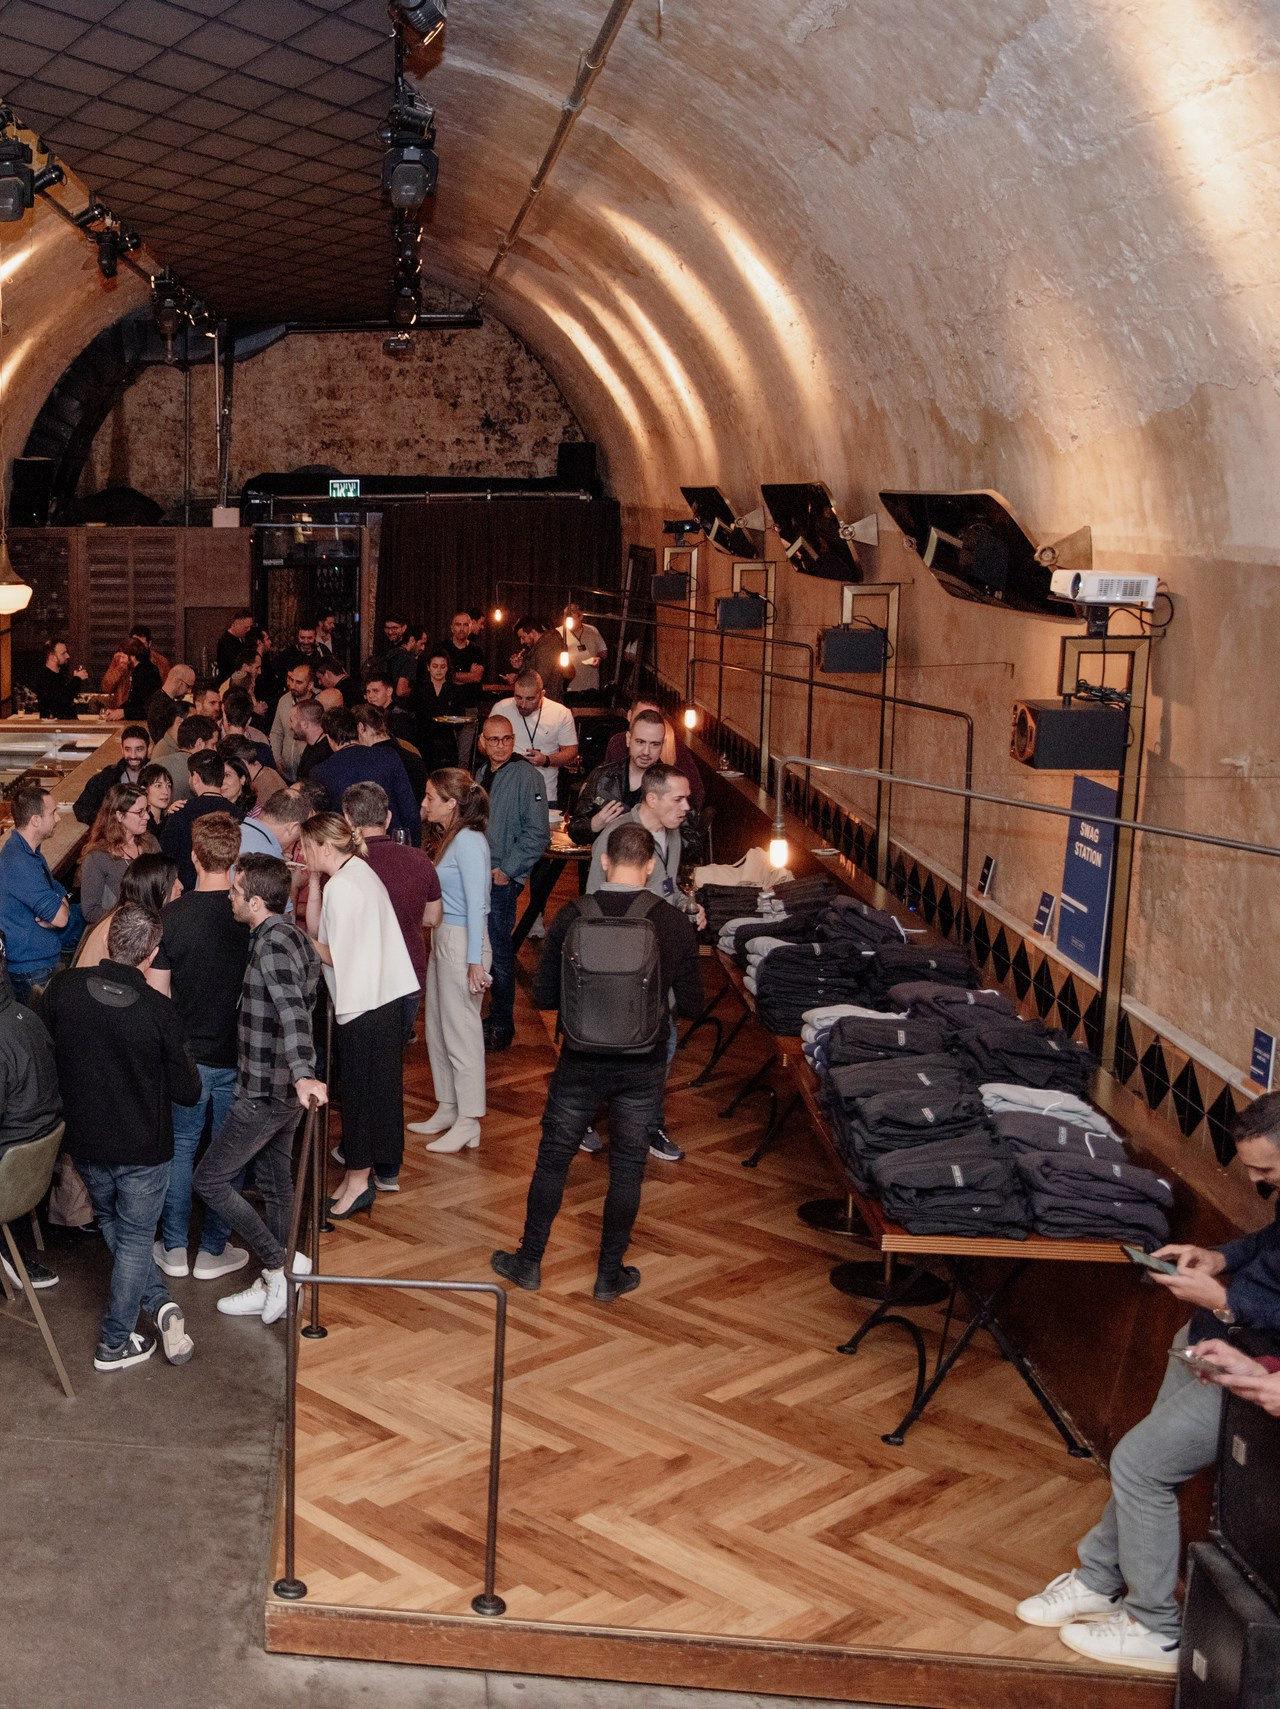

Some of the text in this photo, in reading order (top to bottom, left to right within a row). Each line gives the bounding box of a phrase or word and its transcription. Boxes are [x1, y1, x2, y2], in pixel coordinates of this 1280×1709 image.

[332, 482, 356, 497] יציאה
[1080, 821, 1099, 843] SWAG
[1074, 841, 1102, 868] STATION
